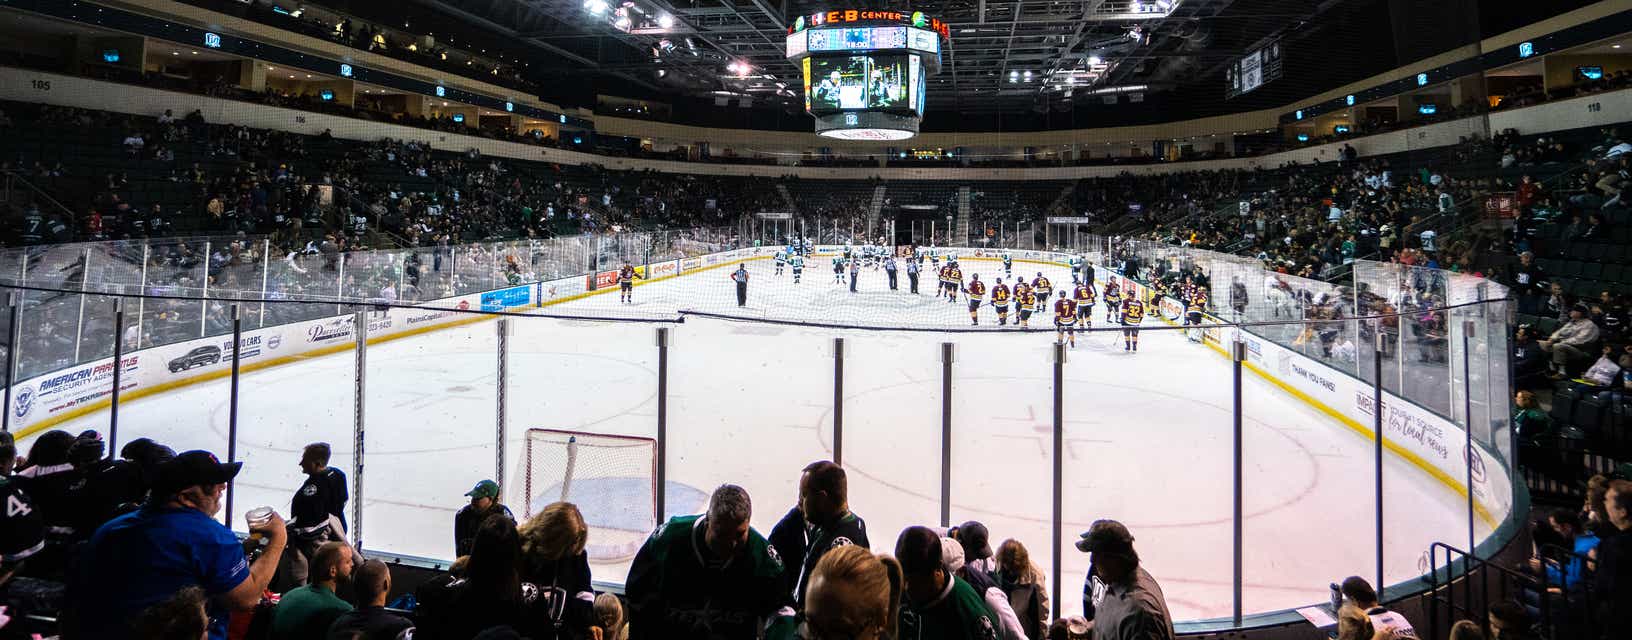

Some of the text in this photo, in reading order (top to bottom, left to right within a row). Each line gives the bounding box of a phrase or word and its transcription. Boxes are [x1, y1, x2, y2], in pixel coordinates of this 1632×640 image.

[861, 11, 902, 20] CENTER
[31, 79, 51, 91] 105
[996, 290, 1007, 300] 14
[1063, 305, 1070, 316] 7
[1128, 304, 1140, 317] 32
[246, 335, 262, 346] CARS
[1291, 363, 1308, 378] THANK
[39, 367, 92, 392] AMERICAN
[52, 377, 92, 394] SECURITY
[93, 369, 128, 382] AGENY
[1357, 393, 1387, 423] IMPAT
[1402, 416, 1425, 446] local
[1426, 436, 1449, 460] news
[7, 494, 33, 518] 4
